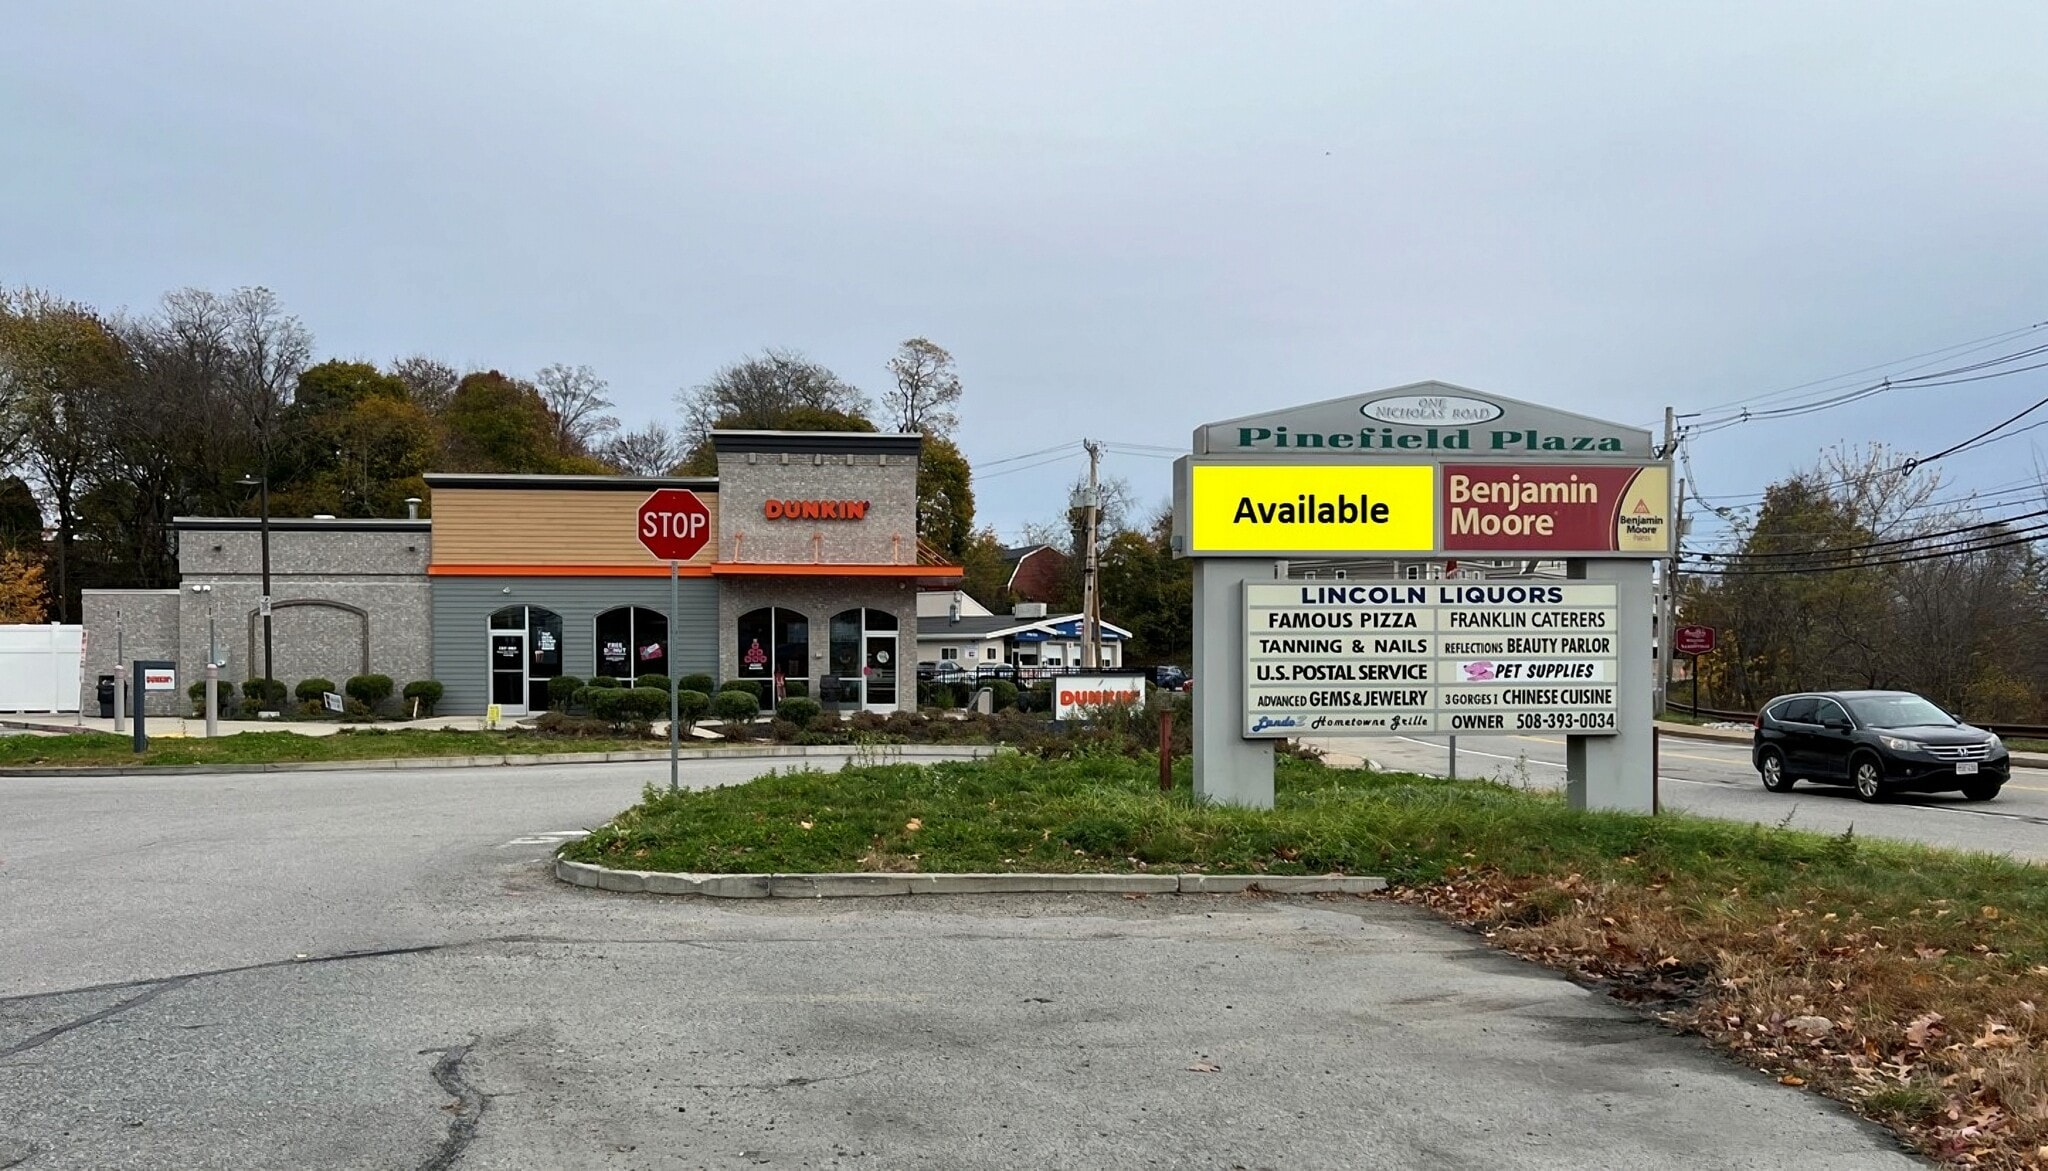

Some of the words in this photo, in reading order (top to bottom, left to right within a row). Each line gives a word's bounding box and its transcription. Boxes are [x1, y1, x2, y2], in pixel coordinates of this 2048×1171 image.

[1418, 398, 1447, 408] ONE
[1375, 406, 1444, 419] NICHOLAS
[1452, 408, 1490, 419] ROAD
[1237, 427, 1469, 450] Pinefield
[1490, 430, 1624, 452] Plaza
[1450, 474, 1598, 511] Benjamin
[764, 499, 871, 521] DUNKIN'
[1233, 494, 1390, 524] Available
[642, 511, 706, 540] STOP
[1451, 506, 1554, 536] Moore
[1620, 515, 1663, 526] Benjamin
[1626, 525, 1657, 534] Moore
[1301, 586, 1426, 604] LINCOLN
[1439, 586, 1563, 604] LIQUORS
[1268, 612, 1353, 629] FAMOUS
[1360, 612, 1417, 628] PIZZA
[1450, 611, 1526, 628] FRANKLIN
[1531, 611, 1606, 628] CATERERS
[1259, 639, 1342, 654] TANNING
[1352, 639, 1365, 654] &
[1374, 639, 1427, 654] NAILS
[1445, 642, 1504, 654] REFLECTIONS
[1507, 638, 1558, 654] BEAUTY
[1561, 637, 1610, 653] PARLOR
[1257, 665, 1290, 681] U.S.
[1292, 664, 1356, 680] POSTAL
[1358, 664, 1428, 680] SERVICE
[1495, 663, 1522, 679] PET
[1527, 663, 1594, 679] SUPPLIES
[1258, 695, 1307, 707] ADVANCED
[1502, 689, 1558, 705] CHINESE
[1560, 689, 1612, 705] CUISINE
[1311, 715, 1386, 730] Hometowne
[1390, 714, 1428, 731] Grille
[1451, 714, 1504, 730] OWNER
[1516, 712, 1615, 730] 508-393-0034
